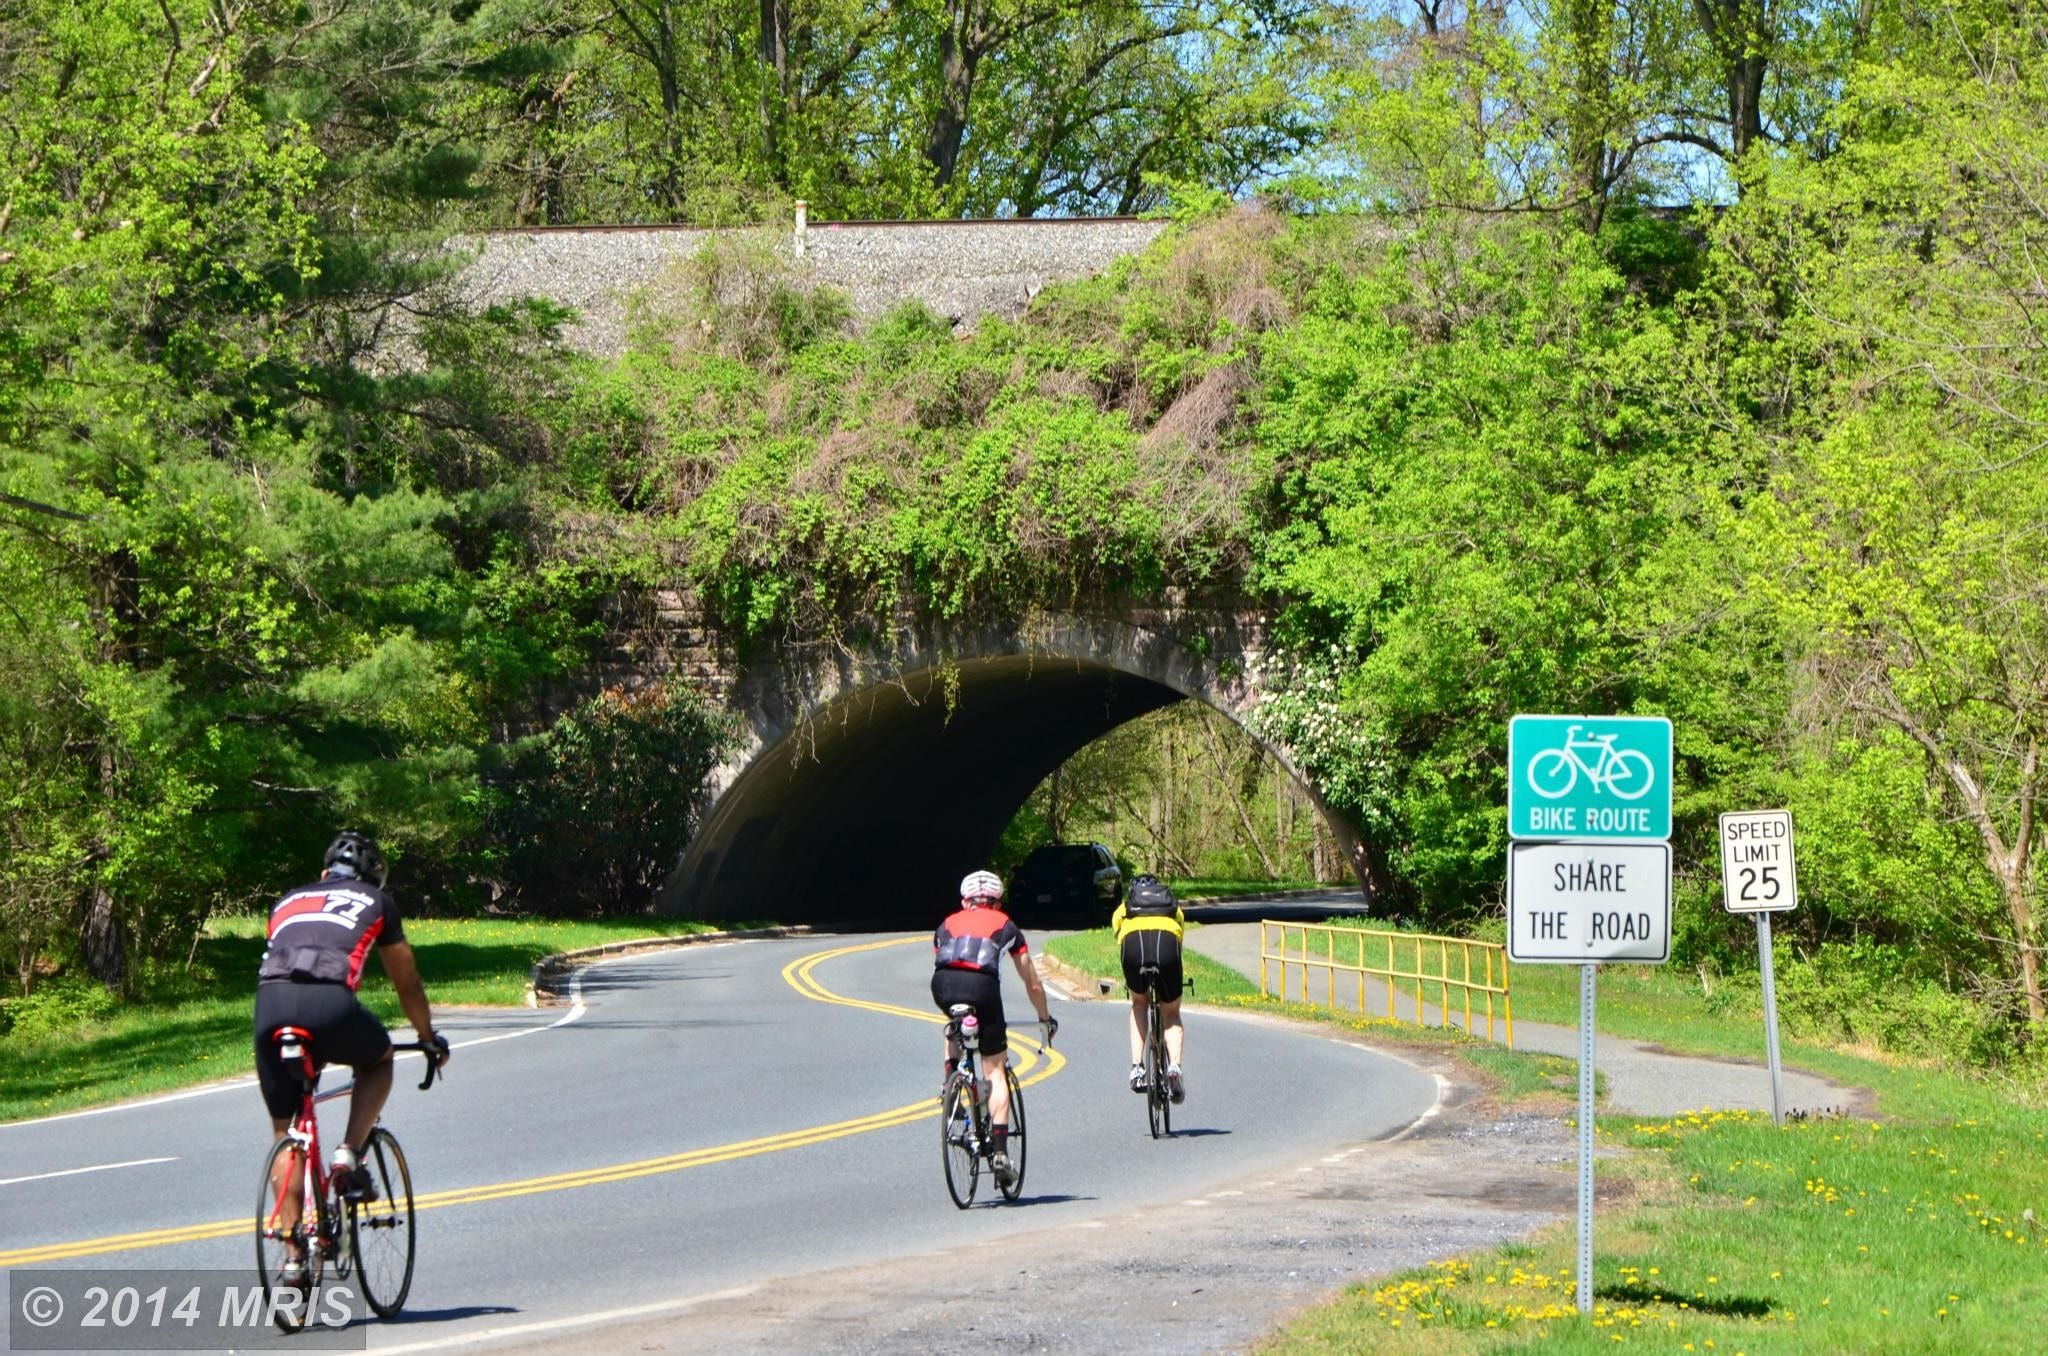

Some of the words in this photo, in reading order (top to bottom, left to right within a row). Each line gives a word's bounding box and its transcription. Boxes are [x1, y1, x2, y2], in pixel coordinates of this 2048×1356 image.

[1530, 807, 1576, 830] BIKE
[1586, 808, 1651, 832] ROUTE
[1728, 821, 1786, 840] SPEED
[1733, 844, 1781, 862] LIMIT
[1554, 862, 1626, 892] SHARE
[1739, 867, 1780, 901] 25
[323, 895, 367, 922] 71
[1529, 911, 1568, 940] THE
[1592, 912, 1650, 940] ROAD
